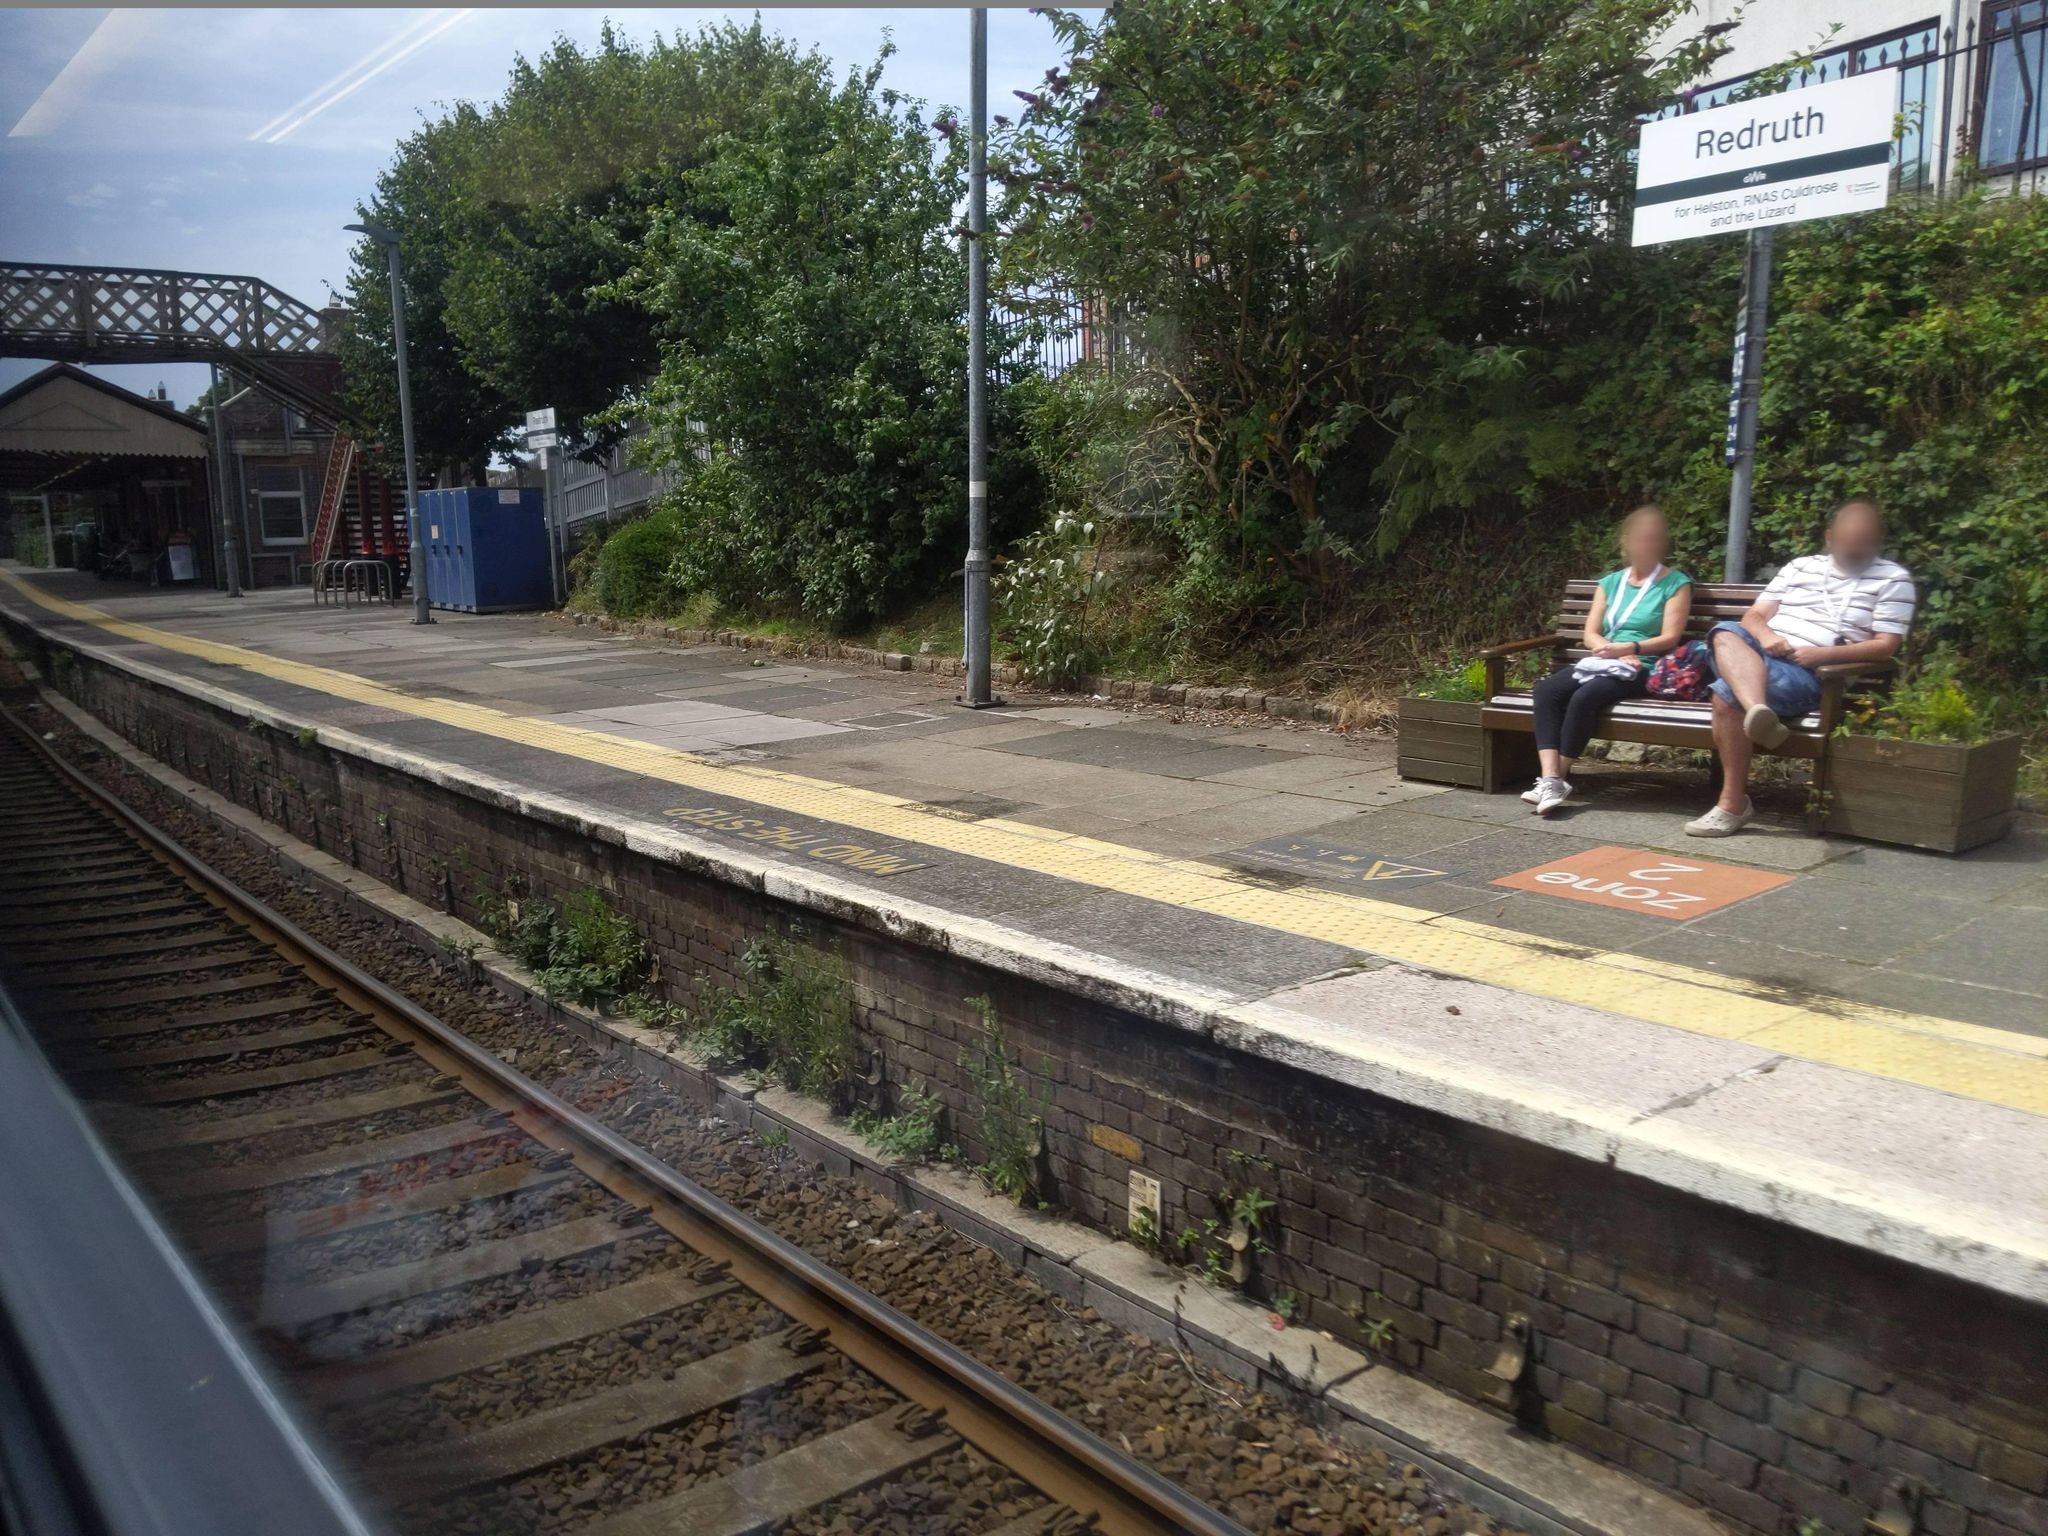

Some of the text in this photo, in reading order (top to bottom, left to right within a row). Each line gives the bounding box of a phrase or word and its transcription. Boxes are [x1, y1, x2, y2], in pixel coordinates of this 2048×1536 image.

[1696, 106, 1824, 159] Redruth
[1674, 206, 1690, 219] for
[1693, 199, 1740, 216] Helston,
[1743, 190, 1778, 206] RNAS
[1781, 181, 1838, 201] Culdrose
[1710, 203, 1796, 227] and the Lizard
[662, 807, 926, 874] MIND THE STEP
[1628, 862, 1704, 881] 2
[1534, 872, 1706, 909] Zone
